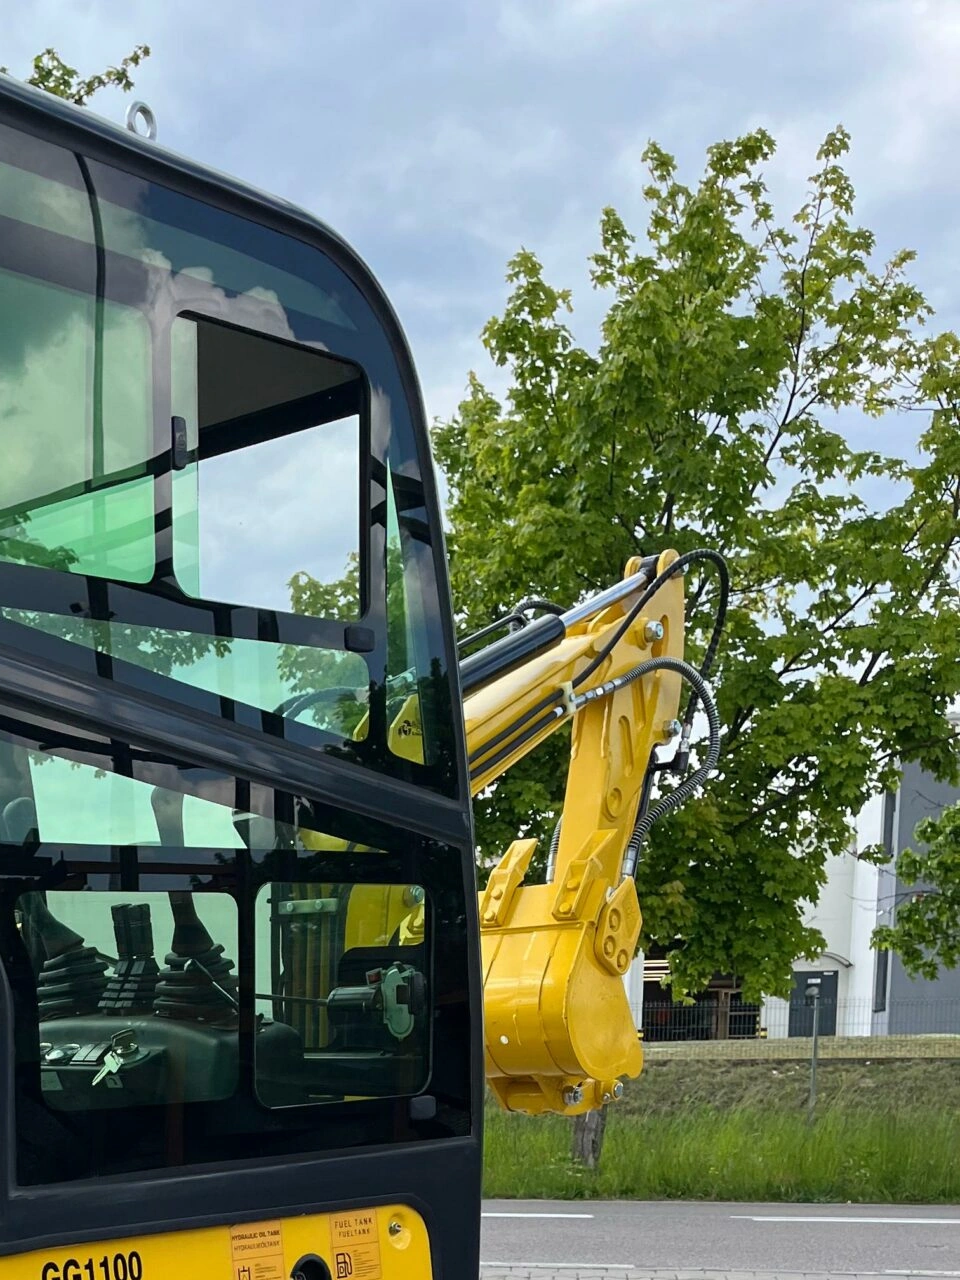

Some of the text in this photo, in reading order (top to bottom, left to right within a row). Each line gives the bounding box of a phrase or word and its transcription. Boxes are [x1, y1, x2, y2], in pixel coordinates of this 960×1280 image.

[334, 1217, 373, 1229] FUEL TANK
[231, 1232, 258, 1241] HYDRAULIC
